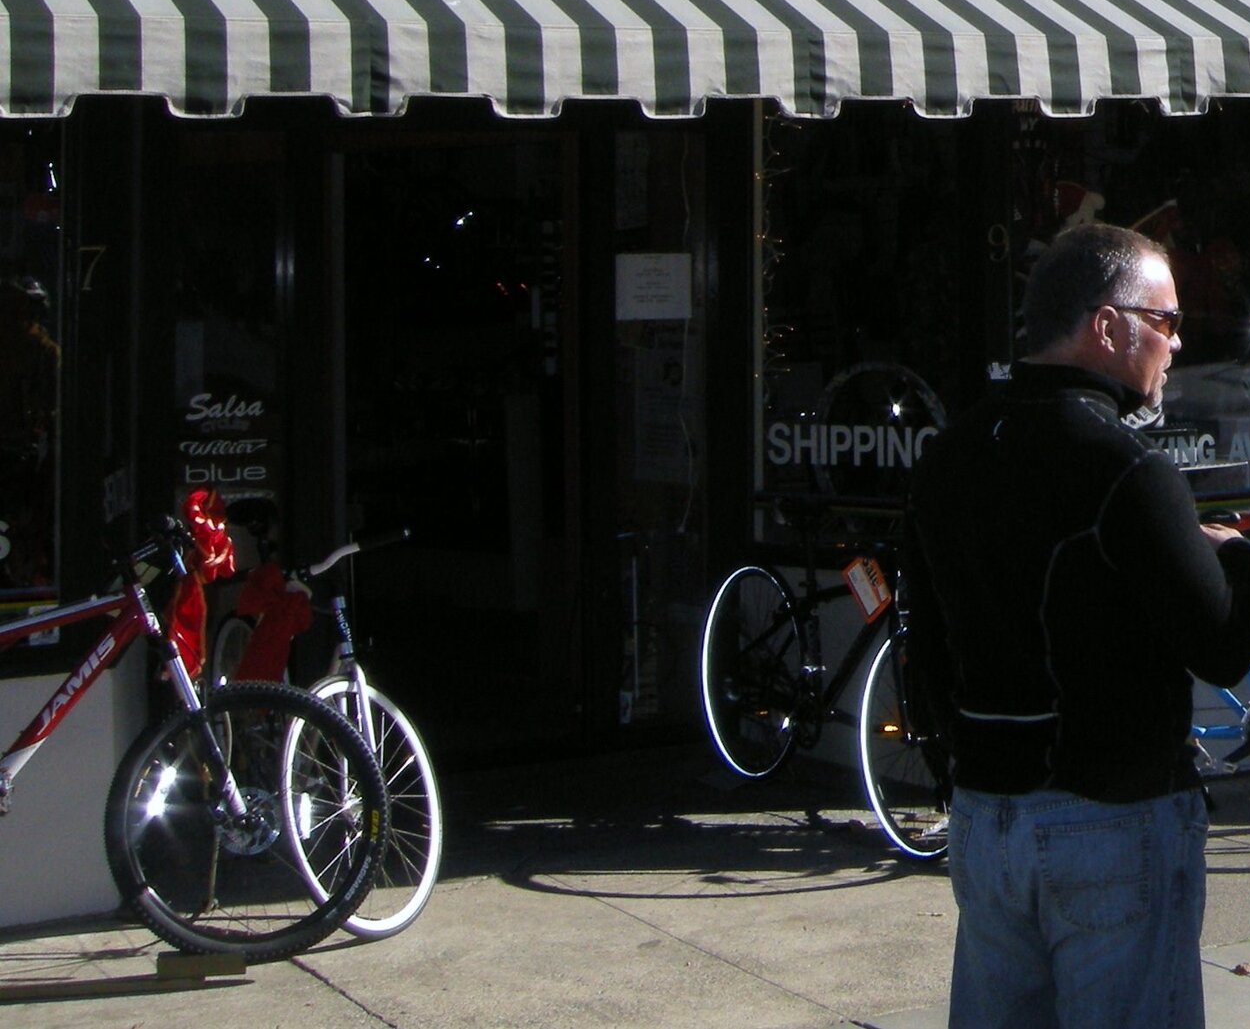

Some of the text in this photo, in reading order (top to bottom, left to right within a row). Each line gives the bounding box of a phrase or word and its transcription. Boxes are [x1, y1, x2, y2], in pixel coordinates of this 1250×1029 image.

[79, 245, 108, 291] 7
[184, 393, 265, 421] Salsa
[185, 463, 266, 484] blue
[37, 633, 117, 736] JAMIS
